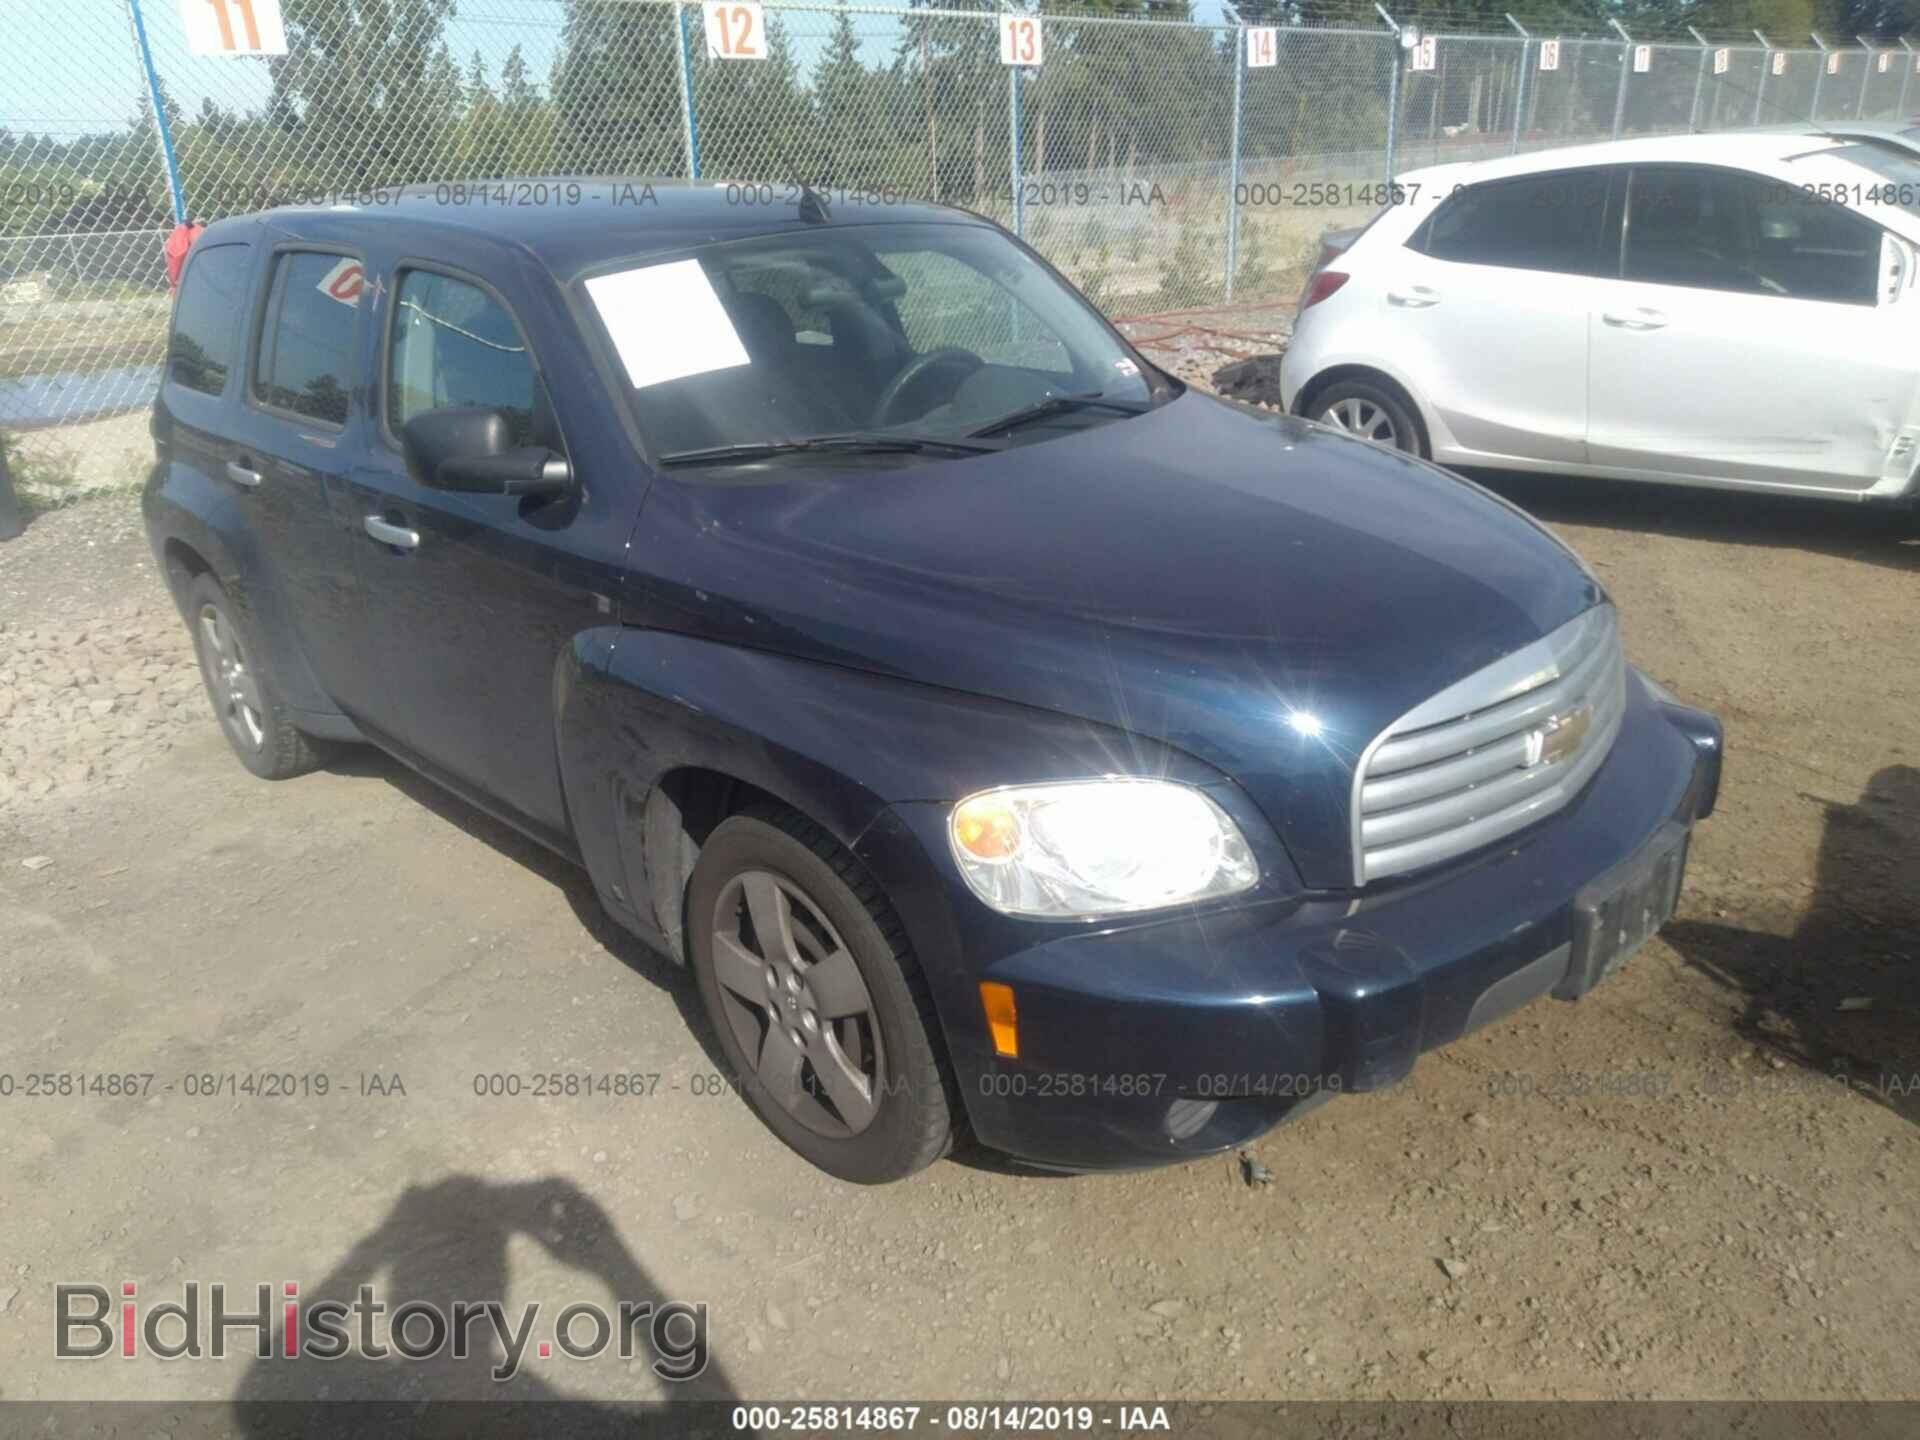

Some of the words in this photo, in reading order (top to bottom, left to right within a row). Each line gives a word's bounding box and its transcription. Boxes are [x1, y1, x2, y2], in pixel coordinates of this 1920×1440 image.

[206, 0, 262, 50] 11
[715, 6, 756, 55] 12
[1008, 20, 1035, 61] 13
[1254, 31, 1273, 64] 14
